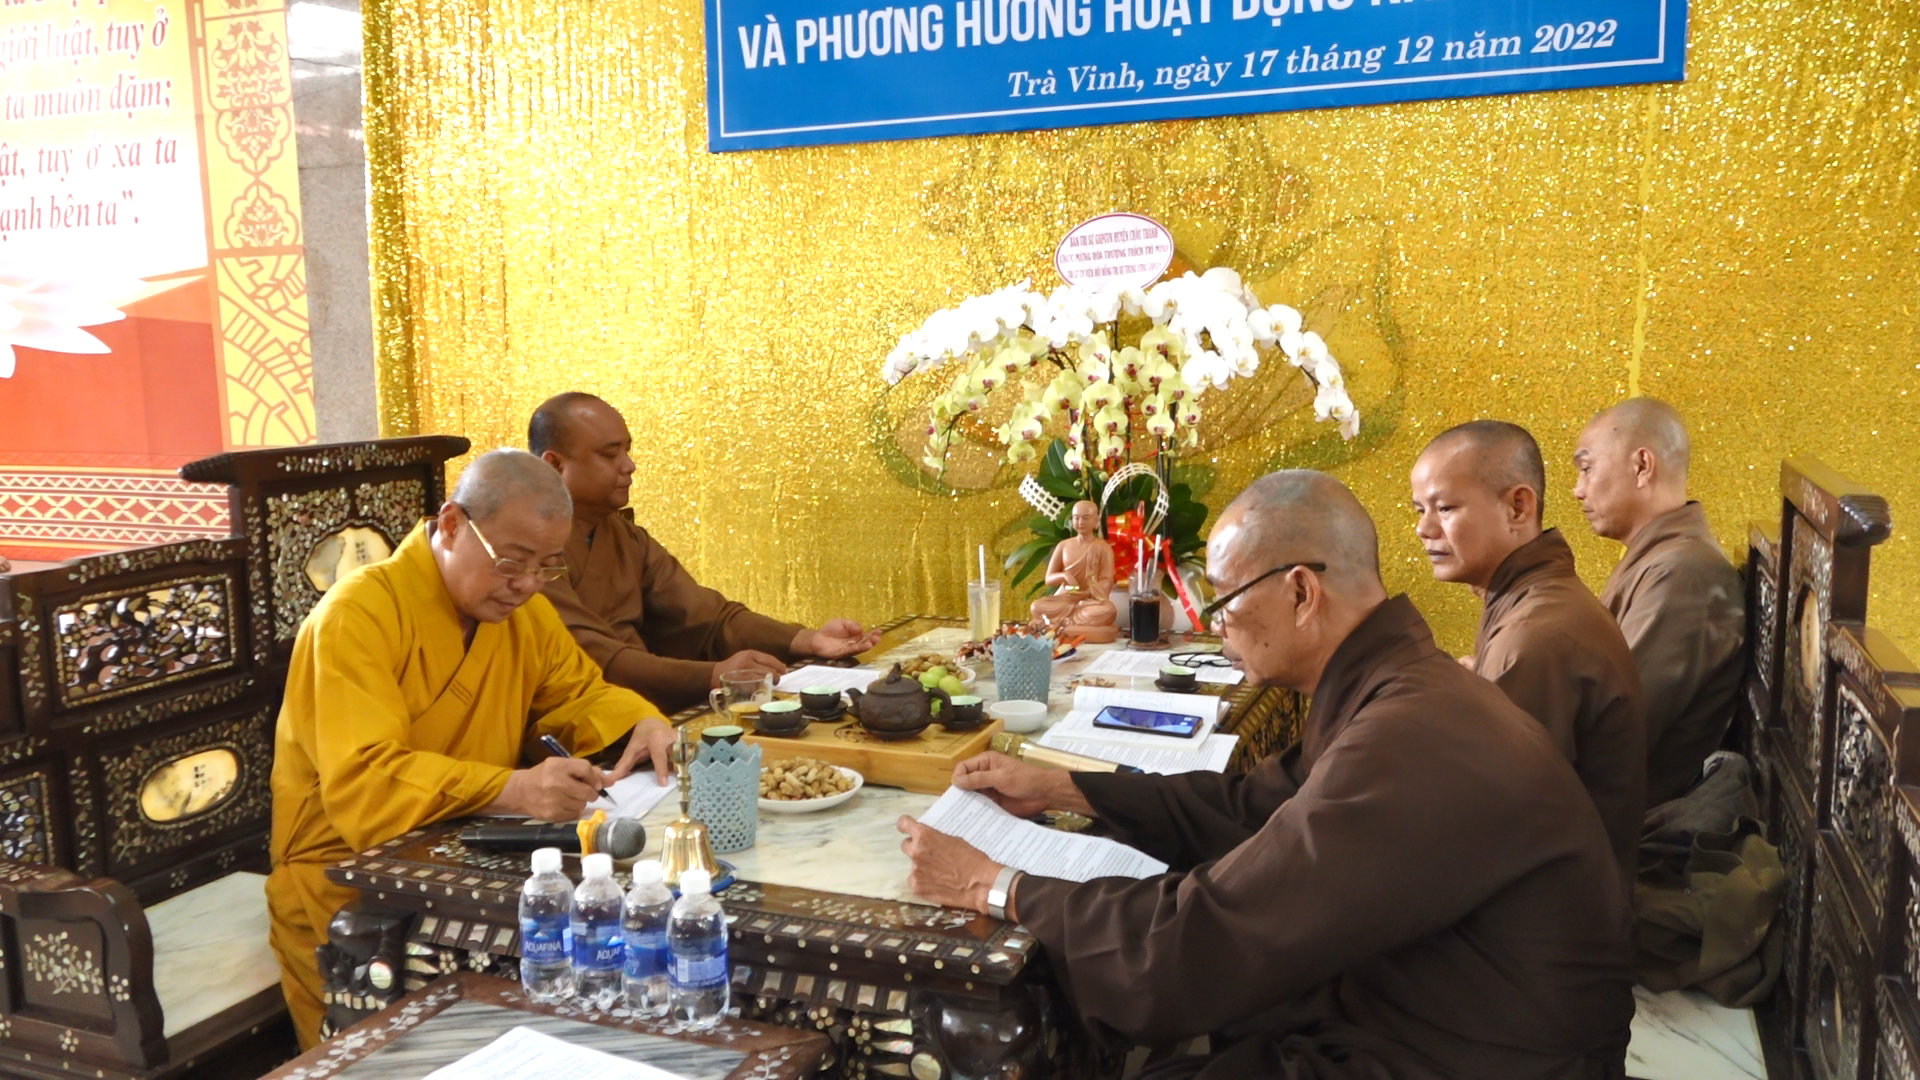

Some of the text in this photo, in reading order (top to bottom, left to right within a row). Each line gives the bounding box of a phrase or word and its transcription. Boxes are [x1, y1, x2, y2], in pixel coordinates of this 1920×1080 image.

[47, 20, 99, 66] luật,
[107, 21, 145, 60] tuy
[152, 8, 169, 47] ở
[738, 13, 786, 69] VÀ
[796, 4, 944, 64] PHƯƠNG
[1008, 19, 1618, 98] Trà Vinh, ngày 17 tháng 12 năm 2022
[5, 73, 172, 121] ta muôn dặm;
[38, 147, 73, 182] tuy
[112, 141, 141, 168] xa
[155, 136, 177, 165] ta
[49, 193, 90, 229] bên
[524, 940, 563, 954] AQUAFINA
